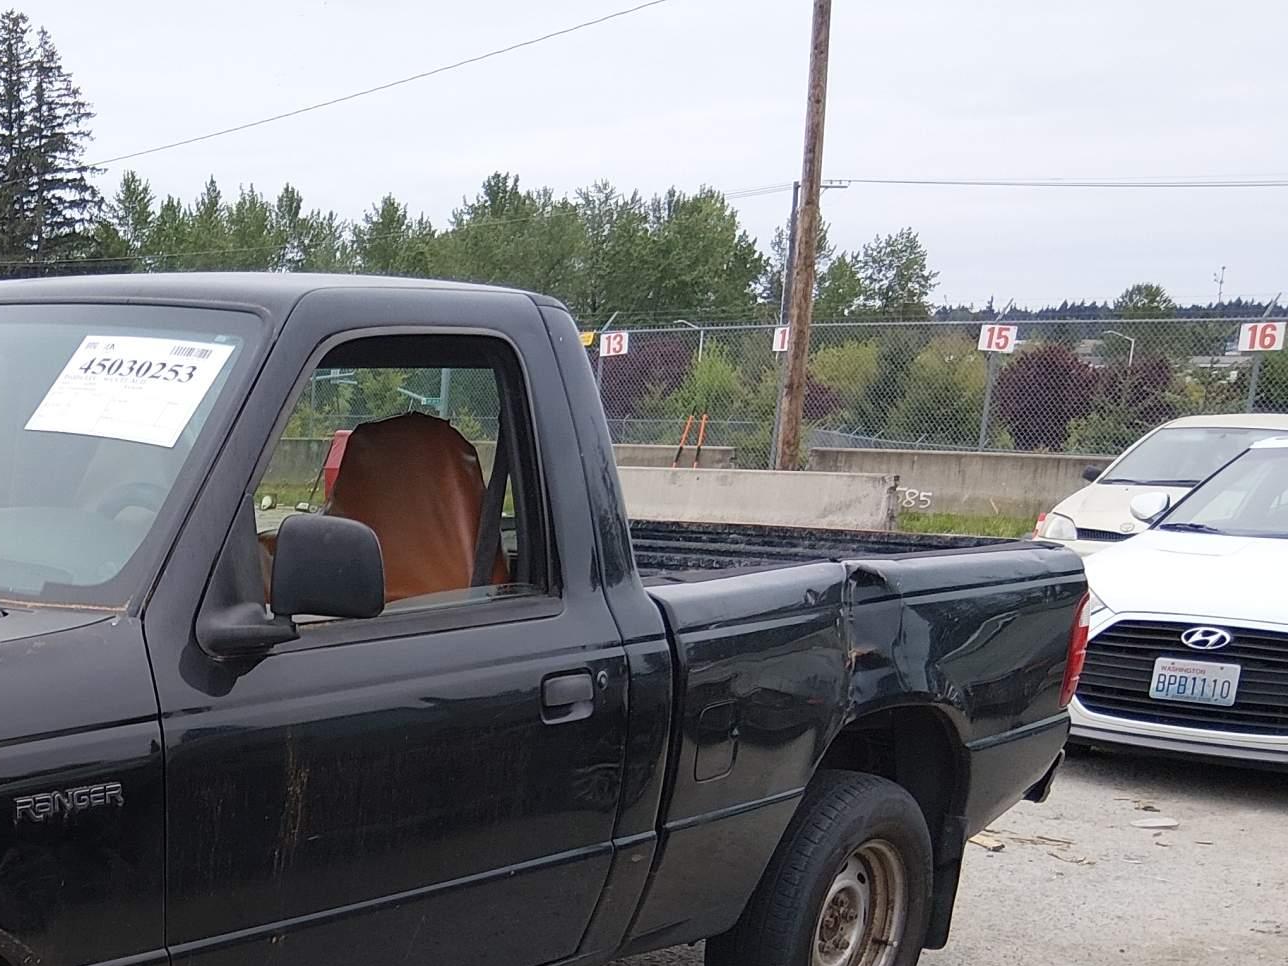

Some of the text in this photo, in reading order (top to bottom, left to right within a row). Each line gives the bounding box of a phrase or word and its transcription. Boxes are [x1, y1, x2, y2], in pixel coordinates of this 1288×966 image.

[606, 334, 623, 354] 13
[987, 327, 1010, 349] 15
[1248, 324, 1277, 349] 16
[79, 357, 197, 383] 45030253
[1160, 665, 1207, 675] WASHINGTON
[1156, 673, 1231, 699] BPB1110
[14, 782, 124, 821] RANGER
